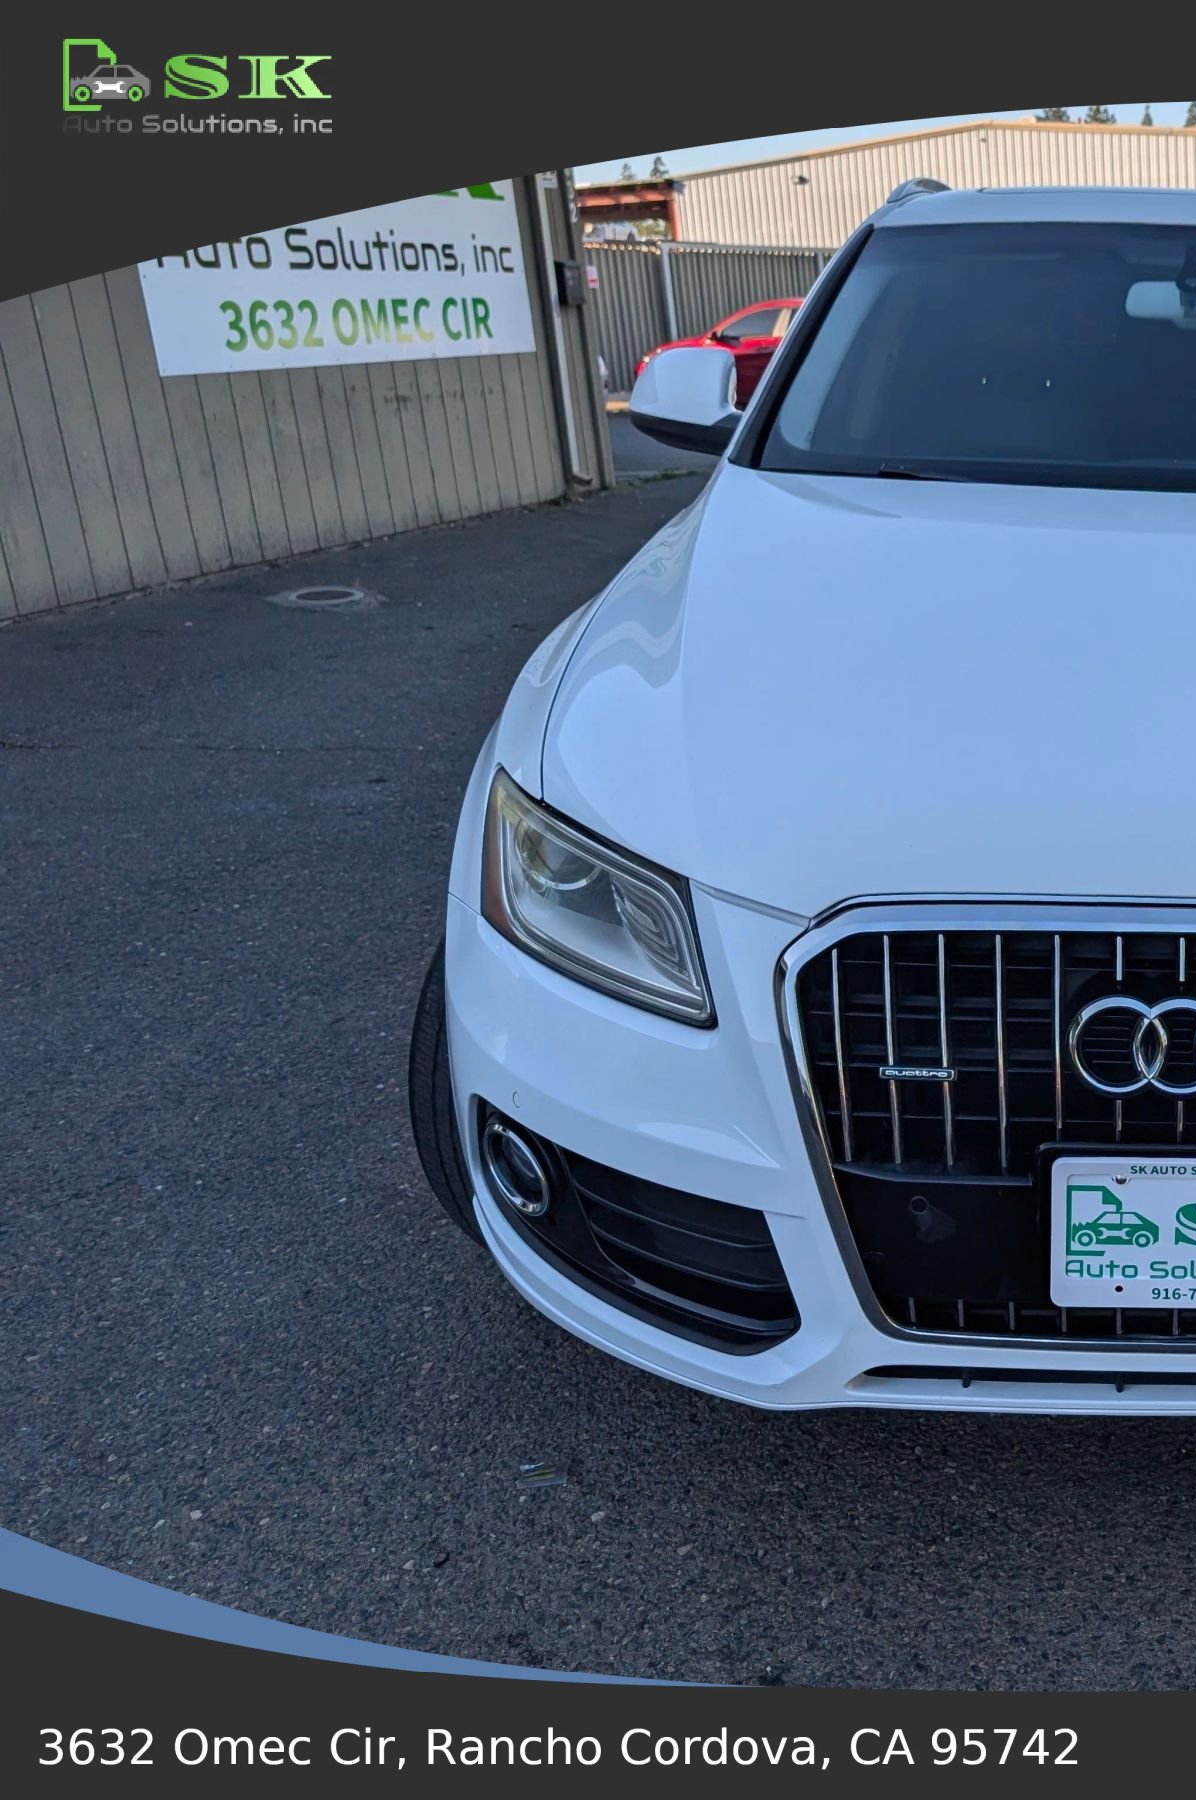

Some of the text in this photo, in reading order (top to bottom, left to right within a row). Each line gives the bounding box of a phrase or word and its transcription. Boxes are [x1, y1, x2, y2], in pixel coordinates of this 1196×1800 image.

[284, 226, 465, 276] Solutions,
[471, 233, 515, 273] inc
[219, 297, 494, 352] 3632 OMEC CIR
[885, 1070, 948, 1078] quattro
[1130, 1165, 1148, 1175] SK
[1150, 1165, 1187, 1175] AUTO
[1065, 1260, 1139, 1279] Auto
